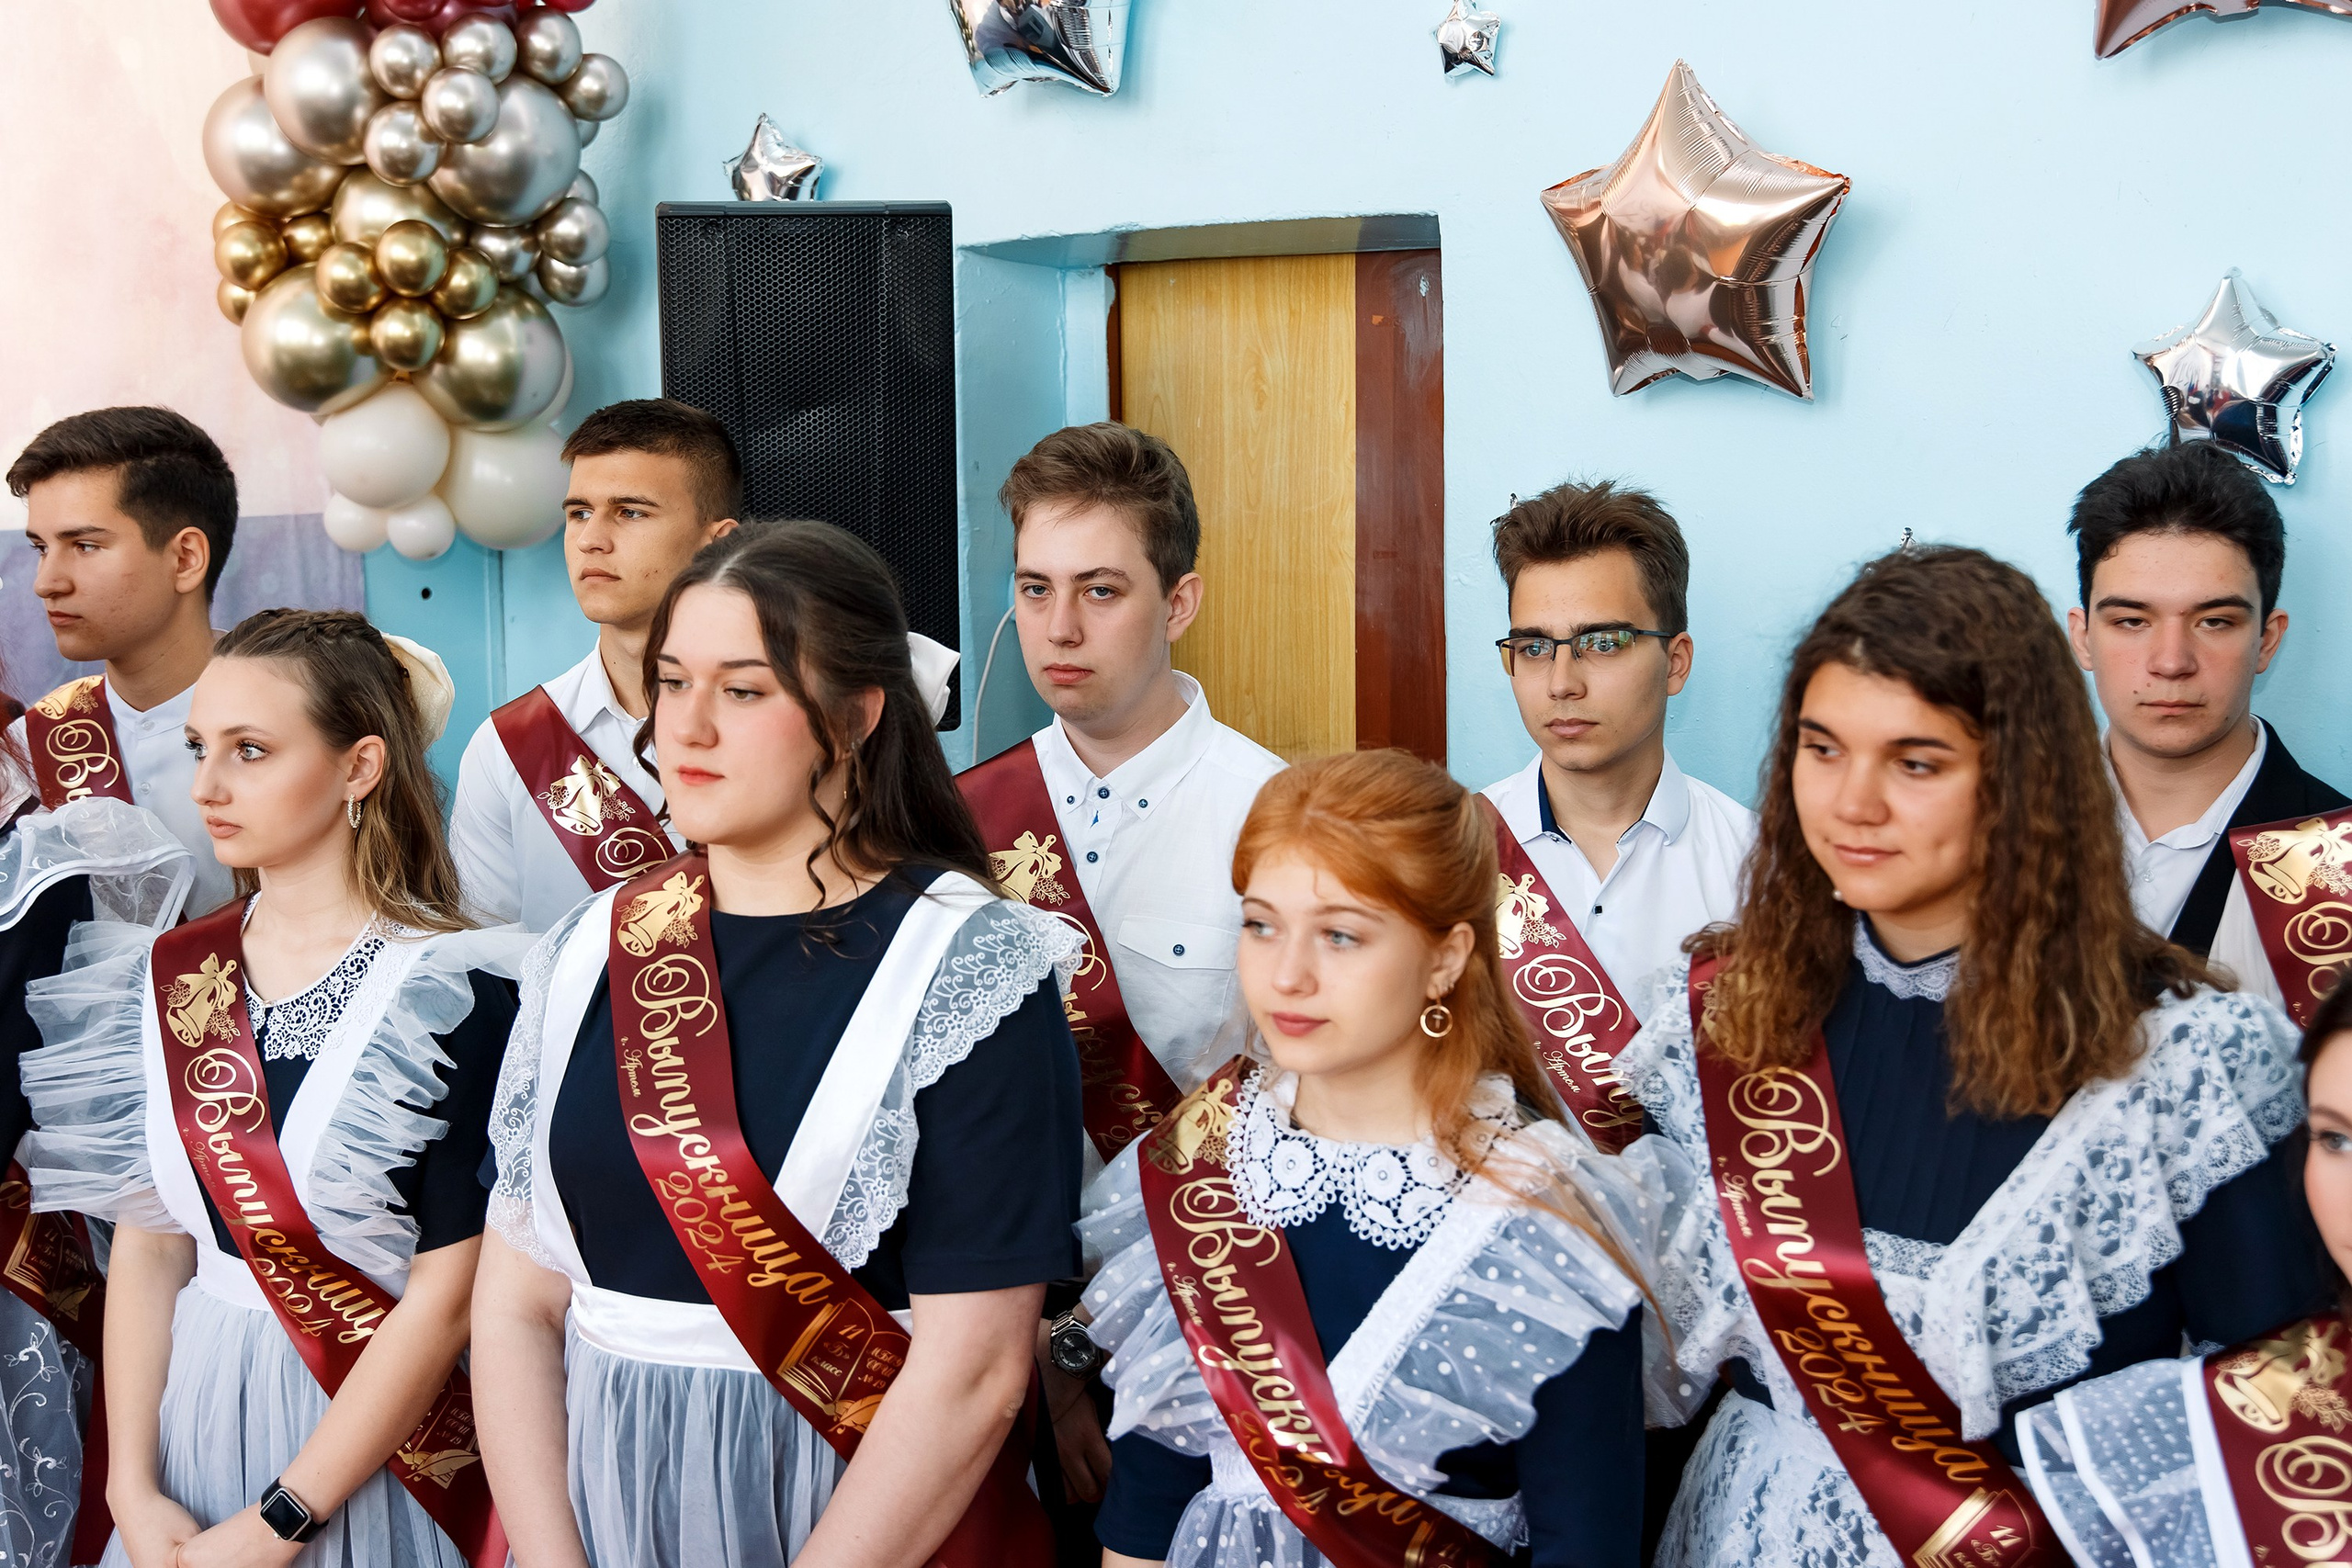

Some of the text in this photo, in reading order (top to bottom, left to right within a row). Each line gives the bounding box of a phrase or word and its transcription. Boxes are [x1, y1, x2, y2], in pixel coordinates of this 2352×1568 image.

[620, 1048, 644, 1098] Артем
[1543, 1049, 1581, 1094] Артем
[630, 953, 834, 1305] Выпускница
[185, 1047, 387, 1344] Выпускниц
[655, 1170, 745, 1275] 2024
[249, 1257, 335, 1337] 2024
[1728, 1066, 1992, 1483] Выпускница
[810, 1355, 843, 1377] класс
[838, 1324, 865, 1340] 11
[1773, 1326, 1890, 1435] 2024
[1989, 1525, 2022, 1548] 11
